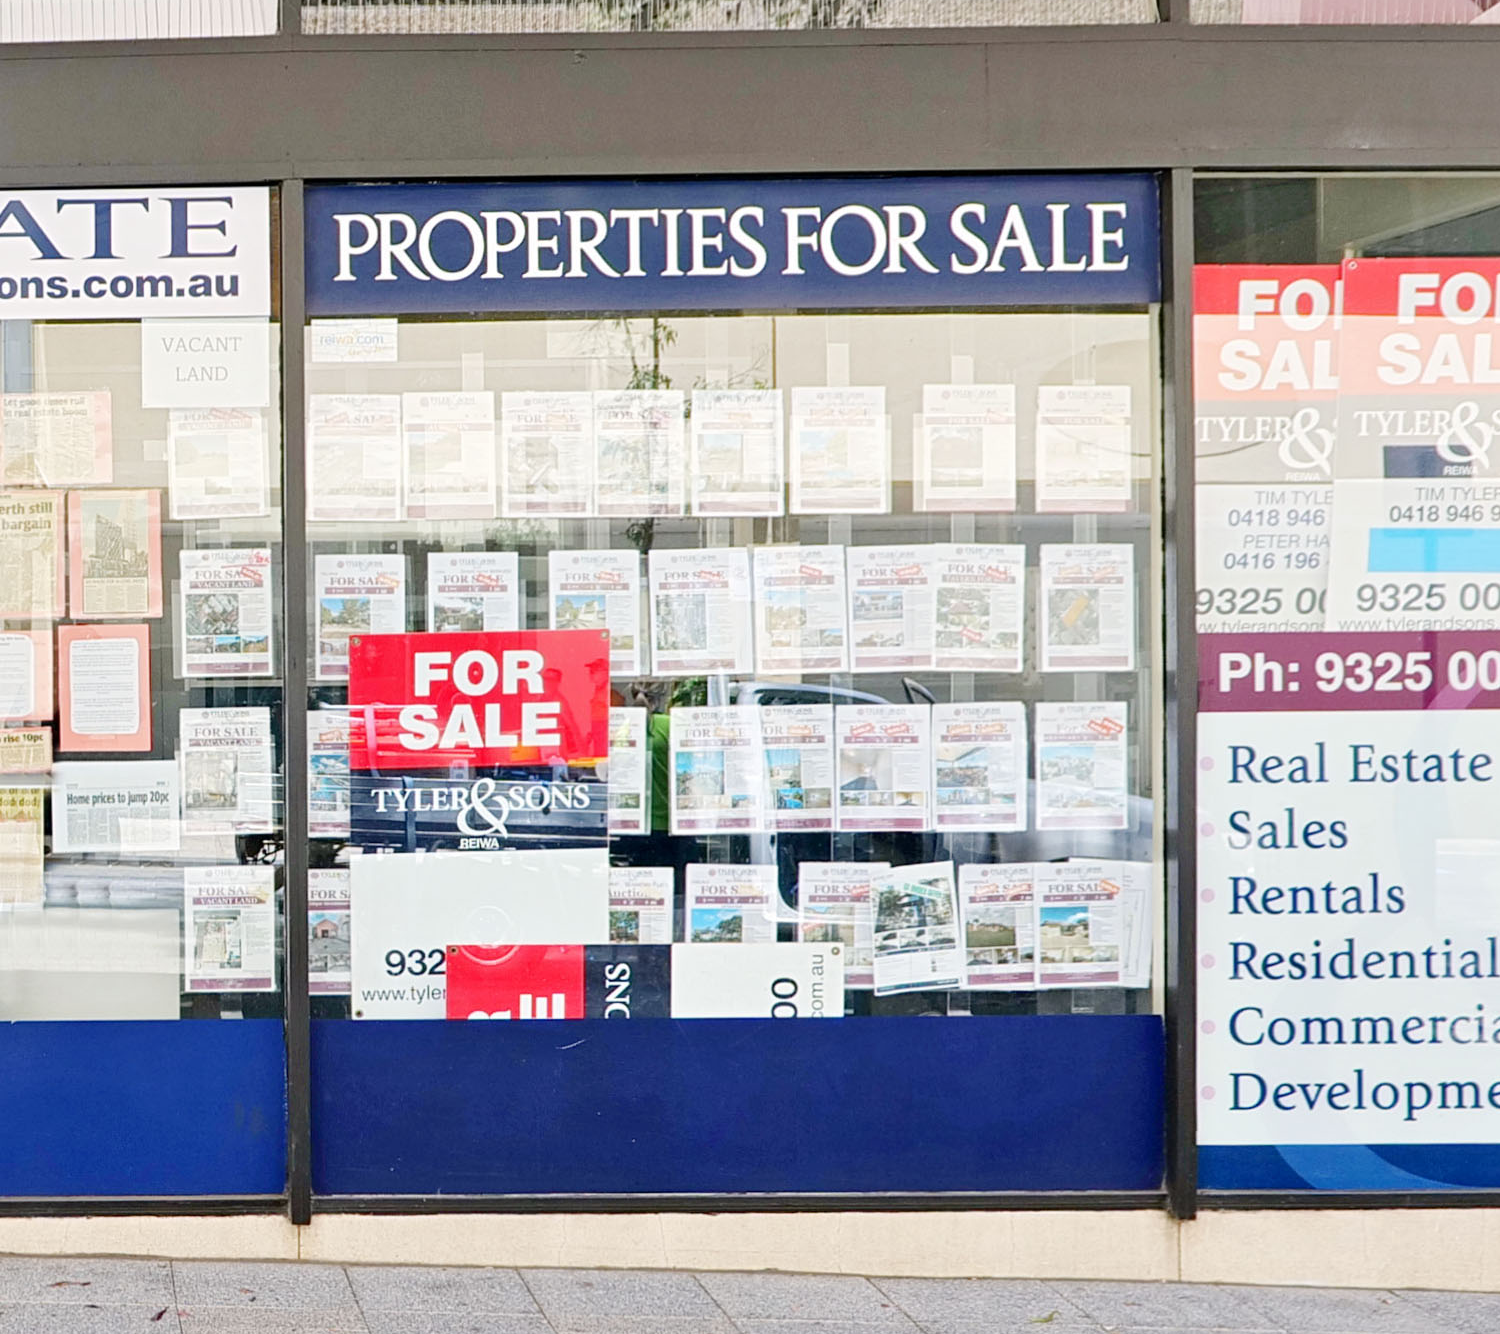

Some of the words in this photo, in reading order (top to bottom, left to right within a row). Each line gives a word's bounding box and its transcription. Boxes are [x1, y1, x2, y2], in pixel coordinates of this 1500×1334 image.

[332, 206, 768, 282] PROPERTIES
[782, 202, 939, 277] FOR
[949, 201, 1130, 275] SALE
[161, 336, 242, 354] VACANT
[175, 365, 229, 383] LAND
[1195, 417, 1292, 442] TYLER
[1353, 410, 1453, 436] TYLER
[1435, 400, 1494, 469] &
[1443, 465, 1479, 476] REIWA
[1255, 490, 1287, 505] TIM
[1414, 487, 1449, 501] TIM
[29, 501, 53, 514] still
[1389, 505, 1440, 522] 0418
[1445, 504, 1484, 521] 946
[2, 519, 52, 532] bargain
[1228, 508, 1282, 527] 0418
[1287, 508, 1325, 526] 946
[1242, 534, 1300, 549] PETER
[1223, 552, 1275, 570] 0416
[1283, 551, 1321, 569] 196
[1195, 587, 1284, 616] 9325
[1356, 583, 1447, 612] 9325
[414, 650, 544, 697] FOR
[1219, 652, 1300, 693] Ph:
[1314, 651, 1433, 692] 9325
[194, 728, 220, 737] FOR
[223, 727, 258, 737] SALE
[398, 702, 561, 751] SALE
[3, 734, 20, 744] rise
[22, 733, 44, 745] 10pc
[1227, 742, 1327, 784] Real
[1348, 744, 1494, 784] Estate
[66, 794, 90, 804] Home
[92, 792, 115, 805] prices
[117, 793, 126, 803] to
[127, 791, 148, 805] jump
[149, 791, 170, 804] 20pc
[371, 787, 468, 813] TYLER
[456, 777, 509, 839] &
[507, 784, 590, 811] SONS
[1227, 808, 1349, 850] Sales
[459, 837, 499, 849] REIWA
[311, 890, 336, 899] FOR
[1049, 885, 1074, 893] FOR
[1228, 873, 1405, 916] Rentals
[385, 949, 446, 976] 932
[1228, 937, 1500, 981] Residential
